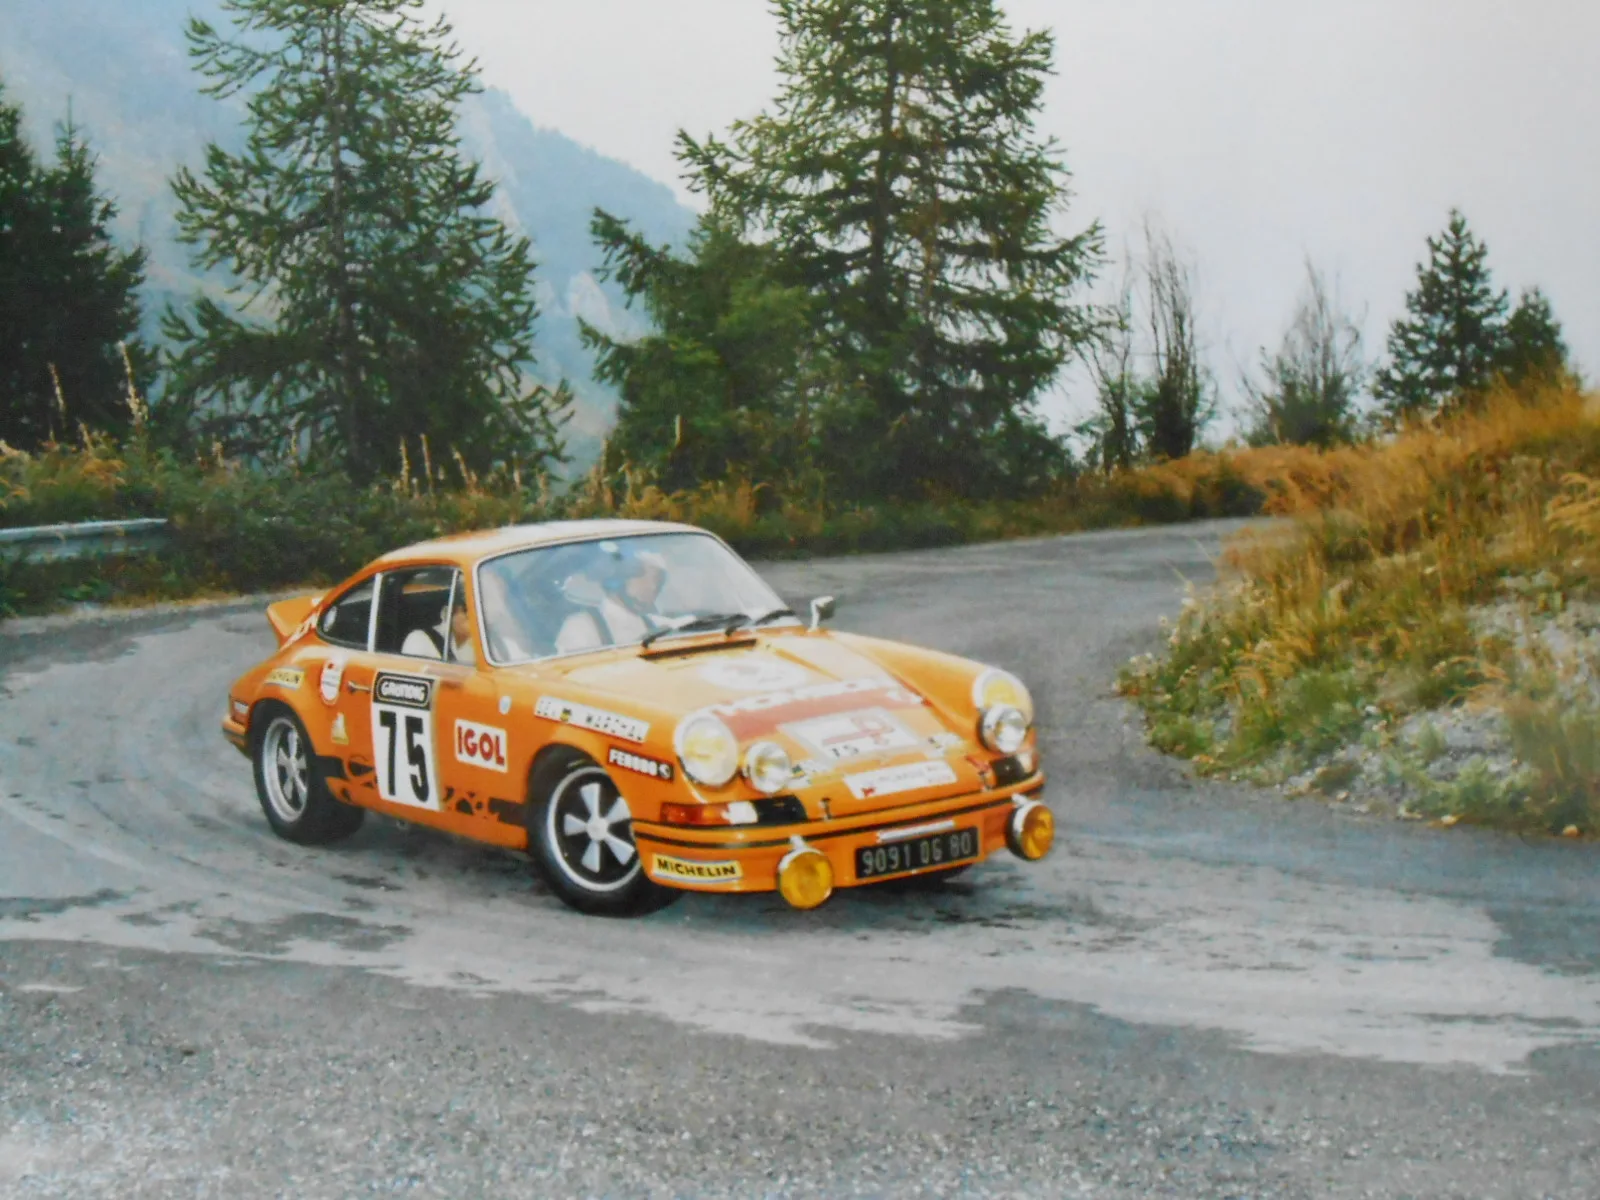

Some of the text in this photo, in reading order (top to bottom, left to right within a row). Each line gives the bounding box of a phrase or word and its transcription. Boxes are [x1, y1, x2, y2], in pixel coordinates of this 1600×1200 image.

[379, 710, 430, 803] 75
[457, 725, 505, 766] IGOL
[657, 857, 737, 876] MICHELIN
[862, 843, 911, 875] 9091
